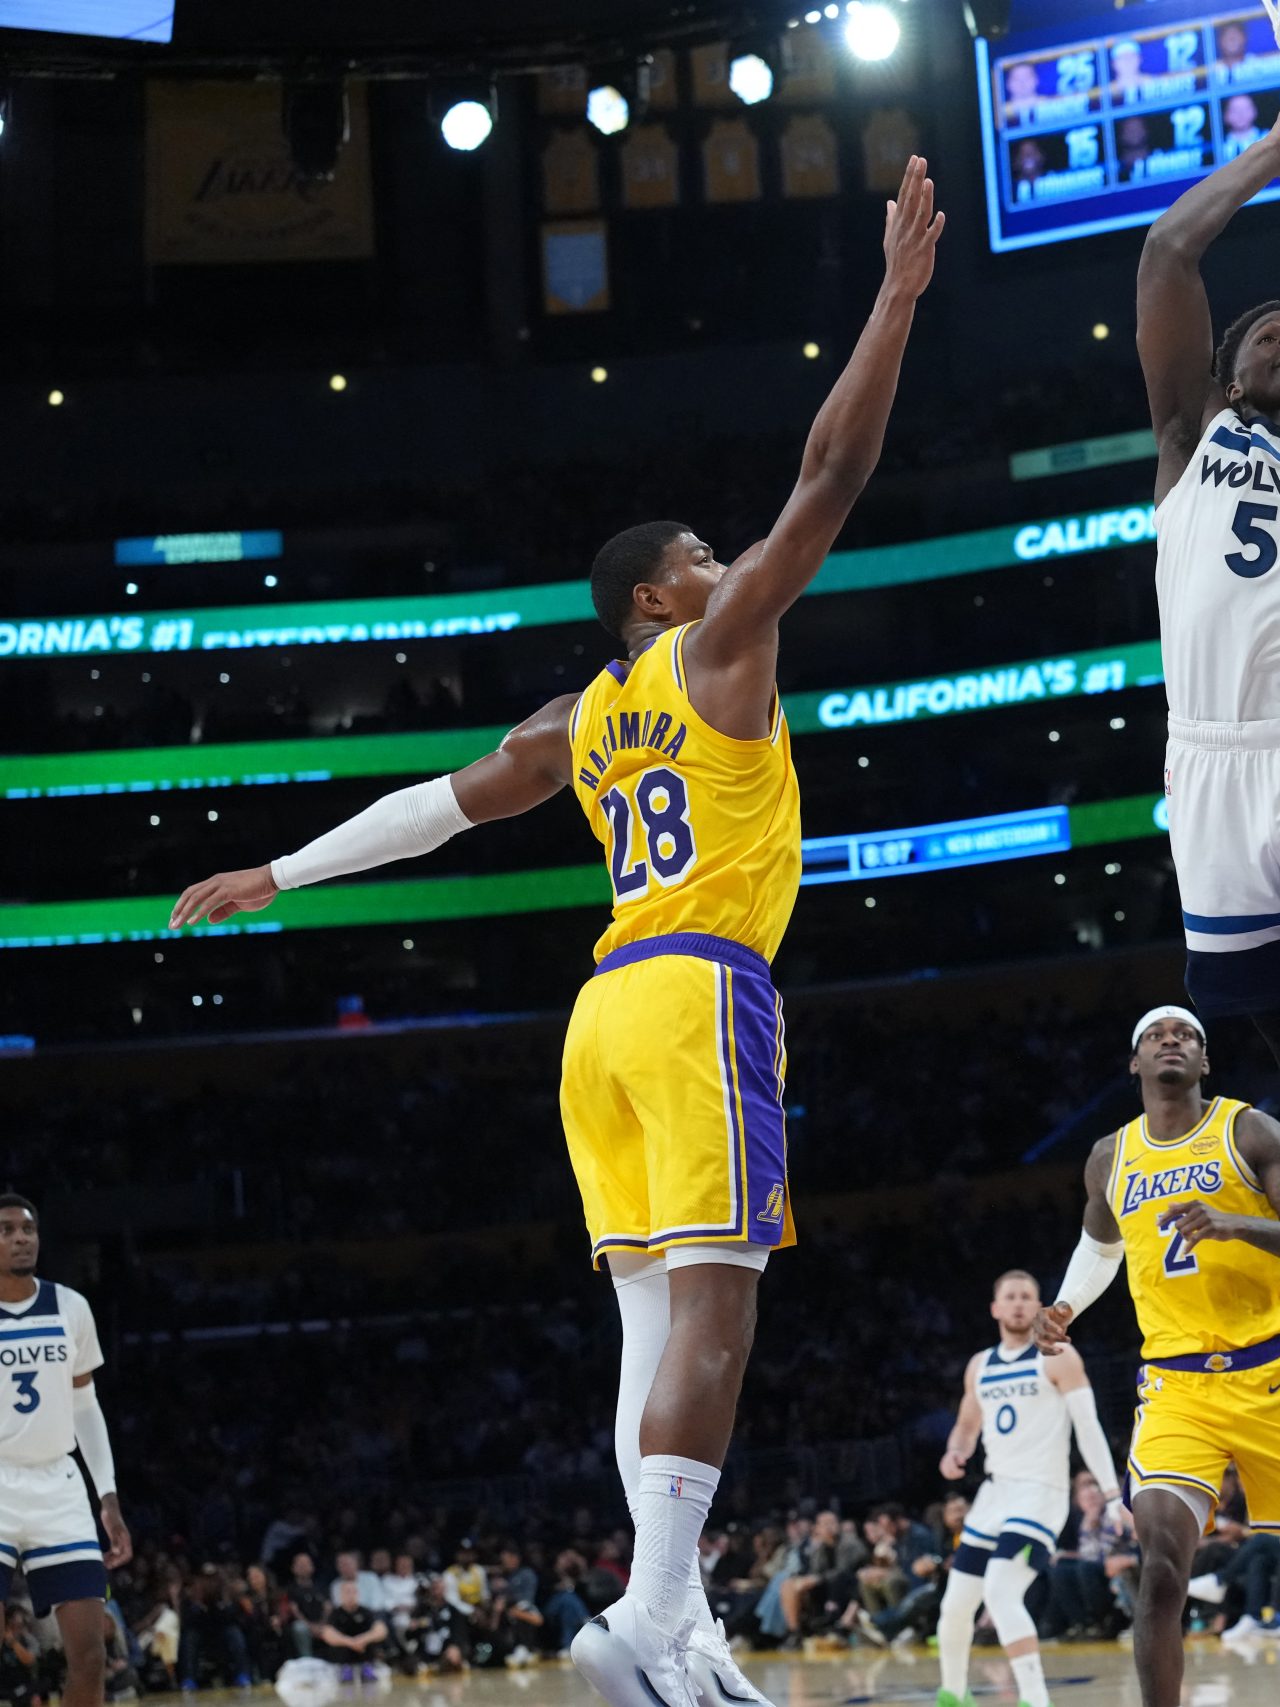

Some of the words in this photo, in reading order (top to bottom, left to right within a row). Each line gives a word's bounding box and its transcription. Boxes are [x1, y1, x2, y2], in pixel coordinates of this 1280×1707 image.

[1224, 500, 1278, 578] 5
[150, 618, 194, 652] #1
[818, 660, 1077, 728] CALIFORNIA'S
[1081, 660, 1126, 694] #1
[600, 765, 698, 906] 28
[1120, 1160, 1223, 1218] LAKERS
[11, 1371, 41, 1414] 3
[981, 1381, 1039, 1399] WOLVES
[996, 1404, 1017, 1434] 0
